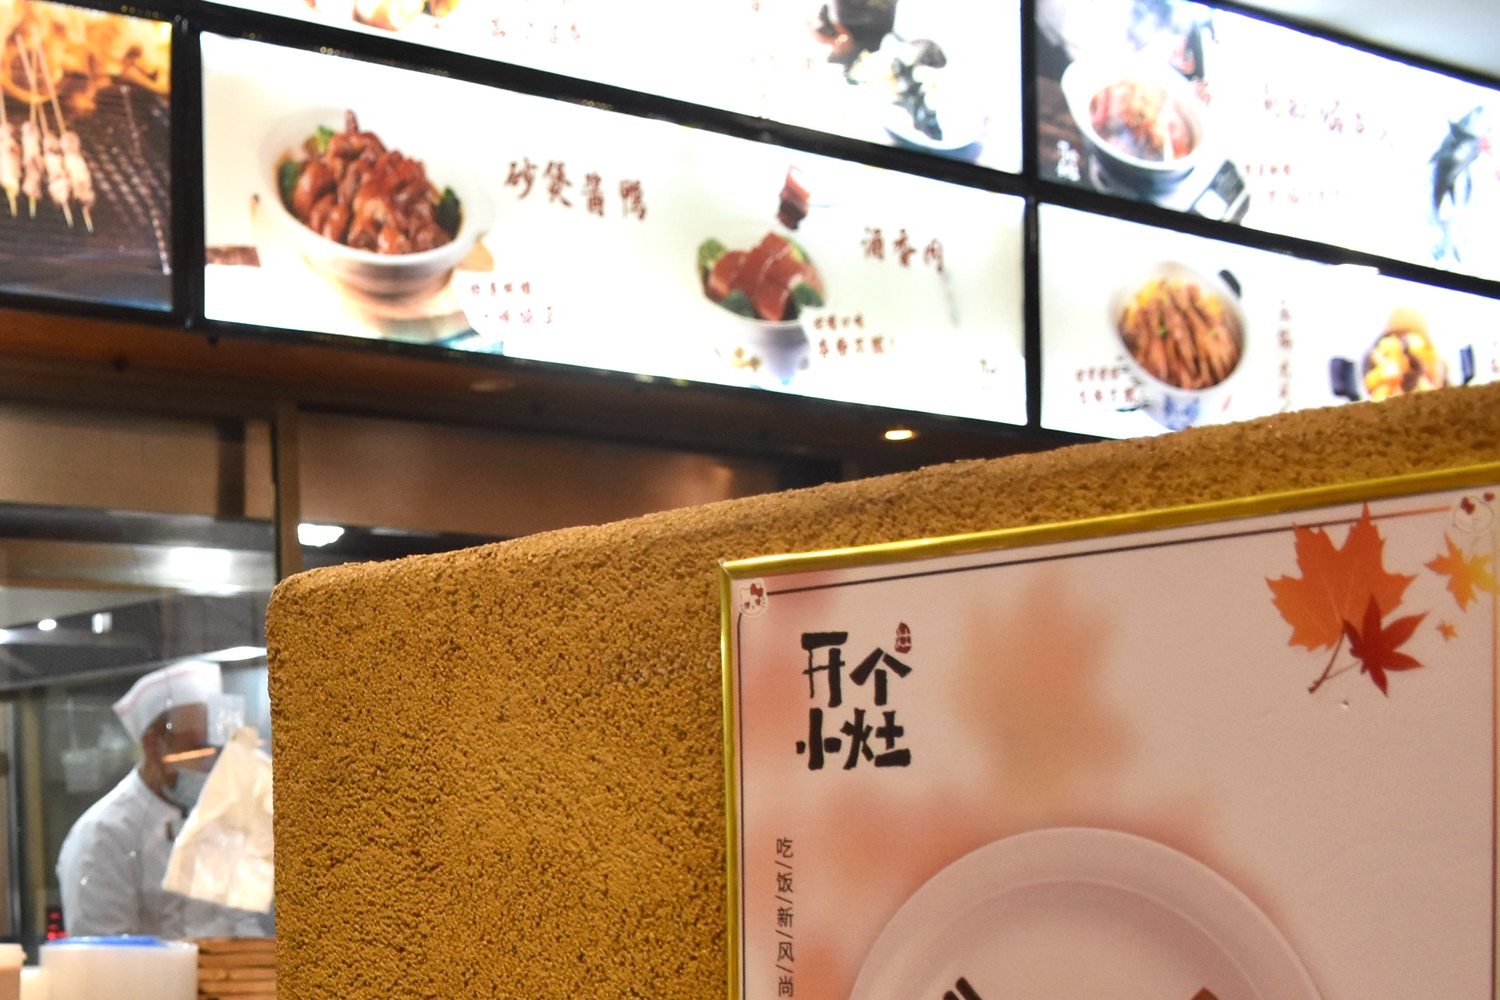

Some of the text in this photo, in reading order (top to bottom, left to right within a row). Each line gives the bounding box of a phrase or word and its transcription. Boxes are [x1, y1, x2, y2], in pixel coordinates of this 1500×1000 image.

[774, 837, 795, 997] 吃/饭/新/风/尚
